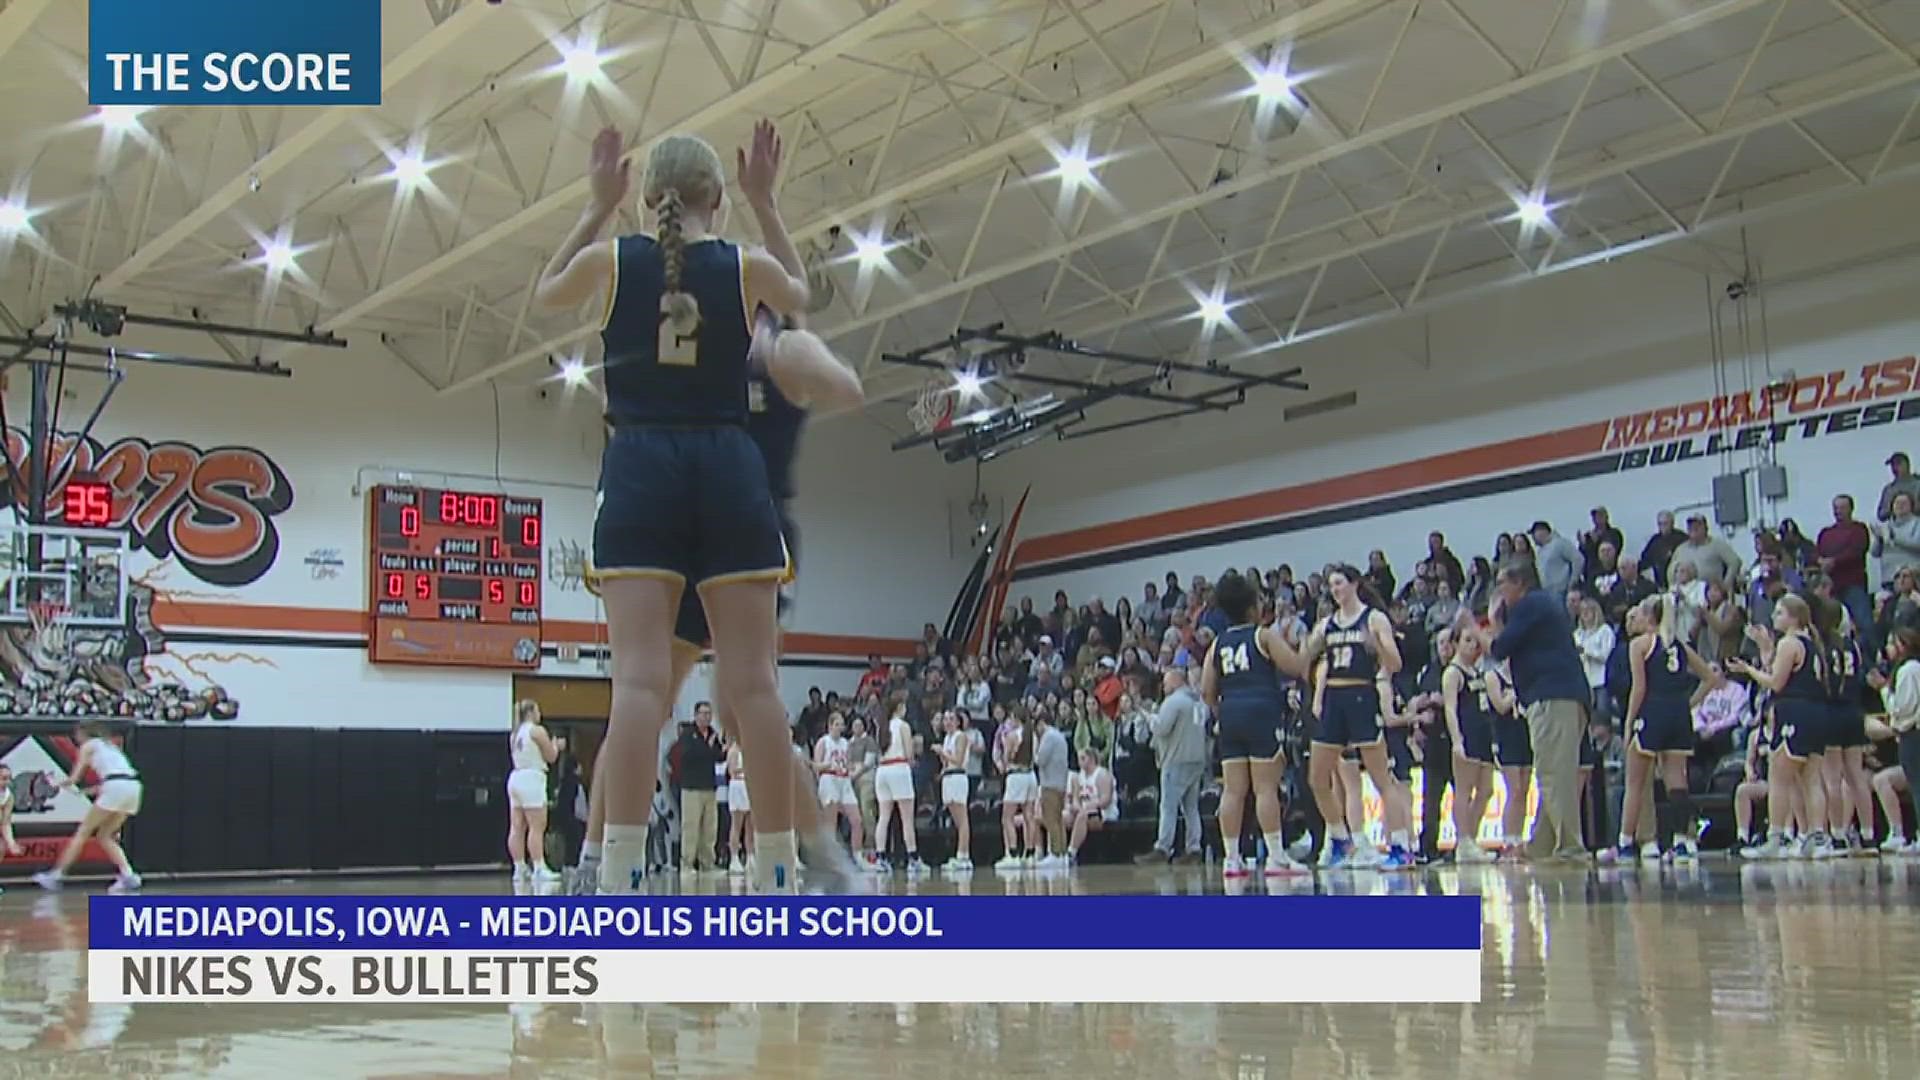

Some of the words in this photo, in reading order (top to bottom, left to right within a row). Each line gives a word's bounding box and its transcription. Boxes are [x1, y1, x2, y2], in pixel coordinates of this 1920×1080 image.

[657, 292, 698, 367] 2
[1606, 355, 1916, 450] MEDIAPOLIS
[1621, 400, 1897, 471] BULLETTES
[66, 485, 109, 521] 35
[441, 493, 496, 525] 8:00
[401, 507, 418, 536] 0
[523, 517, 539, 545] 0
[444, 539, 478, 555] period
[444, 558, 477, 574] player
[388, 574, 403, 597] 0
[416, 575, 430, 598] 5
[490, 580, 503, 602] 5
[520, 583, 534, 605] 0
[444, 604, 477, 619] weight
[1220, 642, 1250, 676] 24
